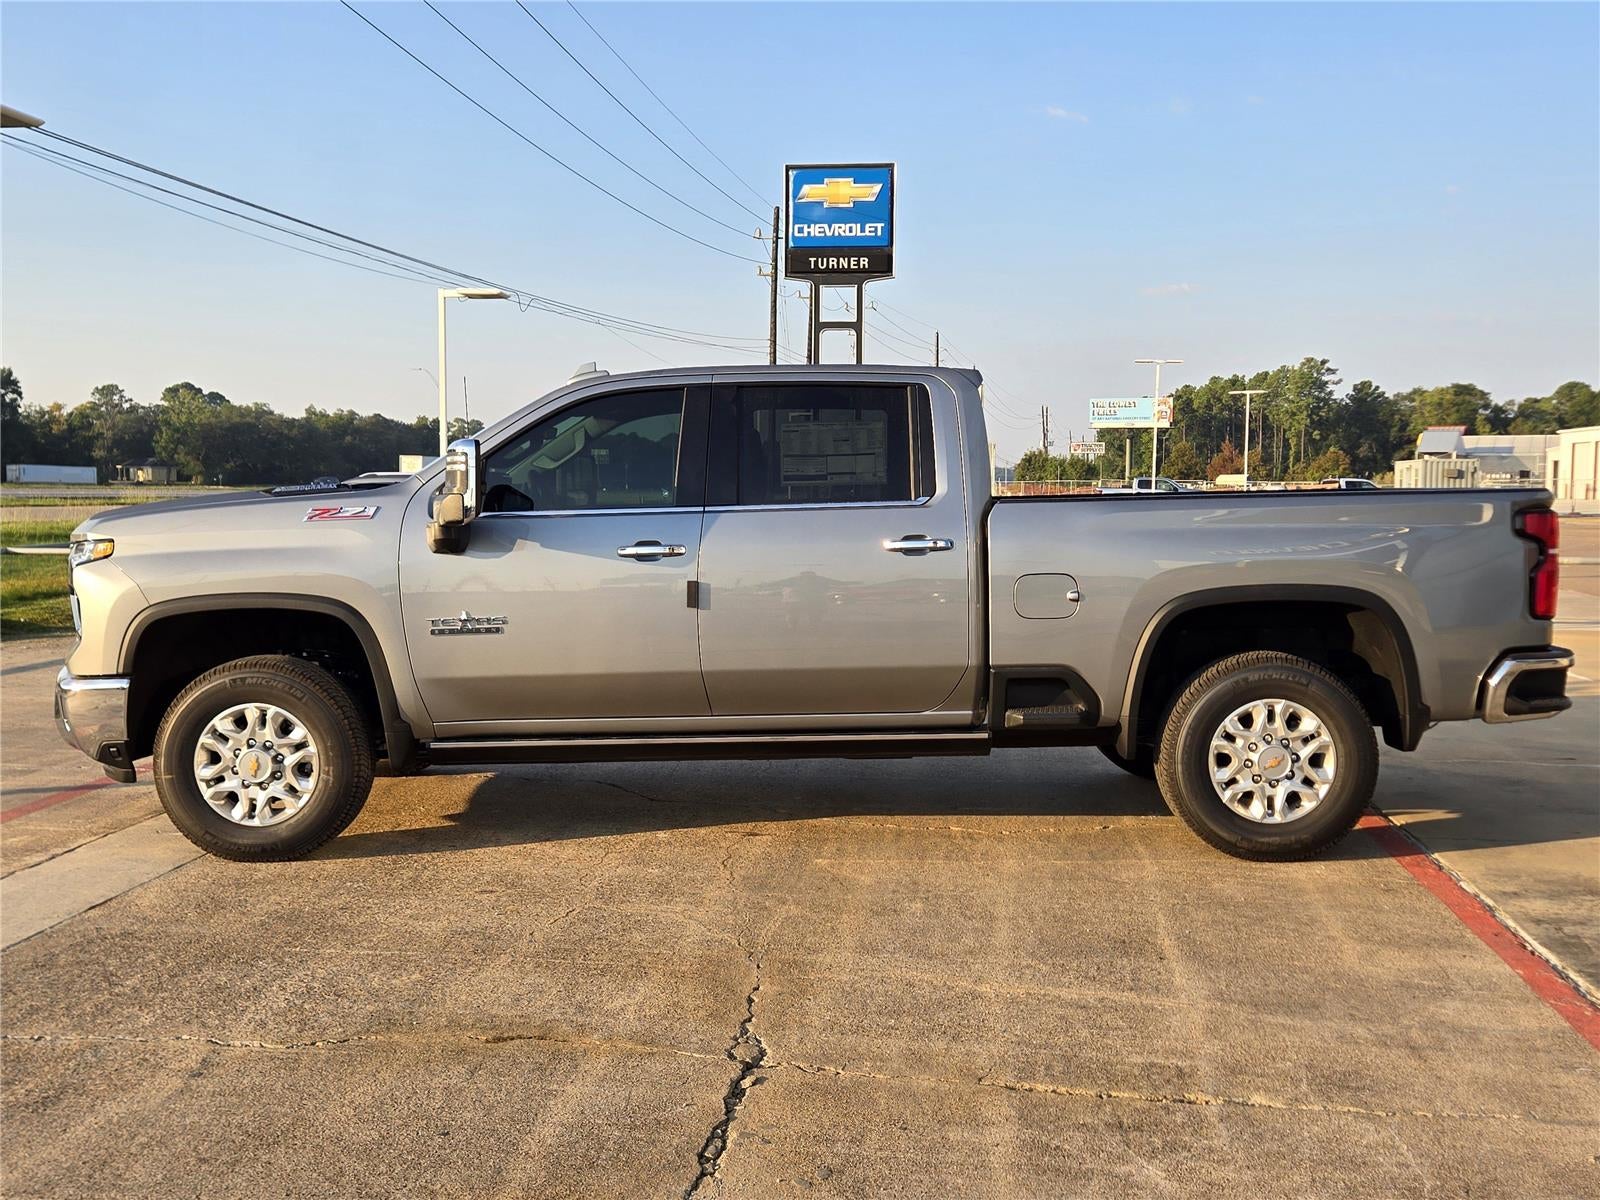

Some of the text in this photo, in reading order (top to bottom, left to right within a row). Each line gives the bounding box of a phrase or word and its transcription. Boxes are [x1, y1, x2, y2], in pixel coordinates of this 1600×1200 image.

[794, 223, 885, 237] CHEVROLET
[808, 257, 869, 269] TURNER
[245, 676, 305, 699] MICHELIN
